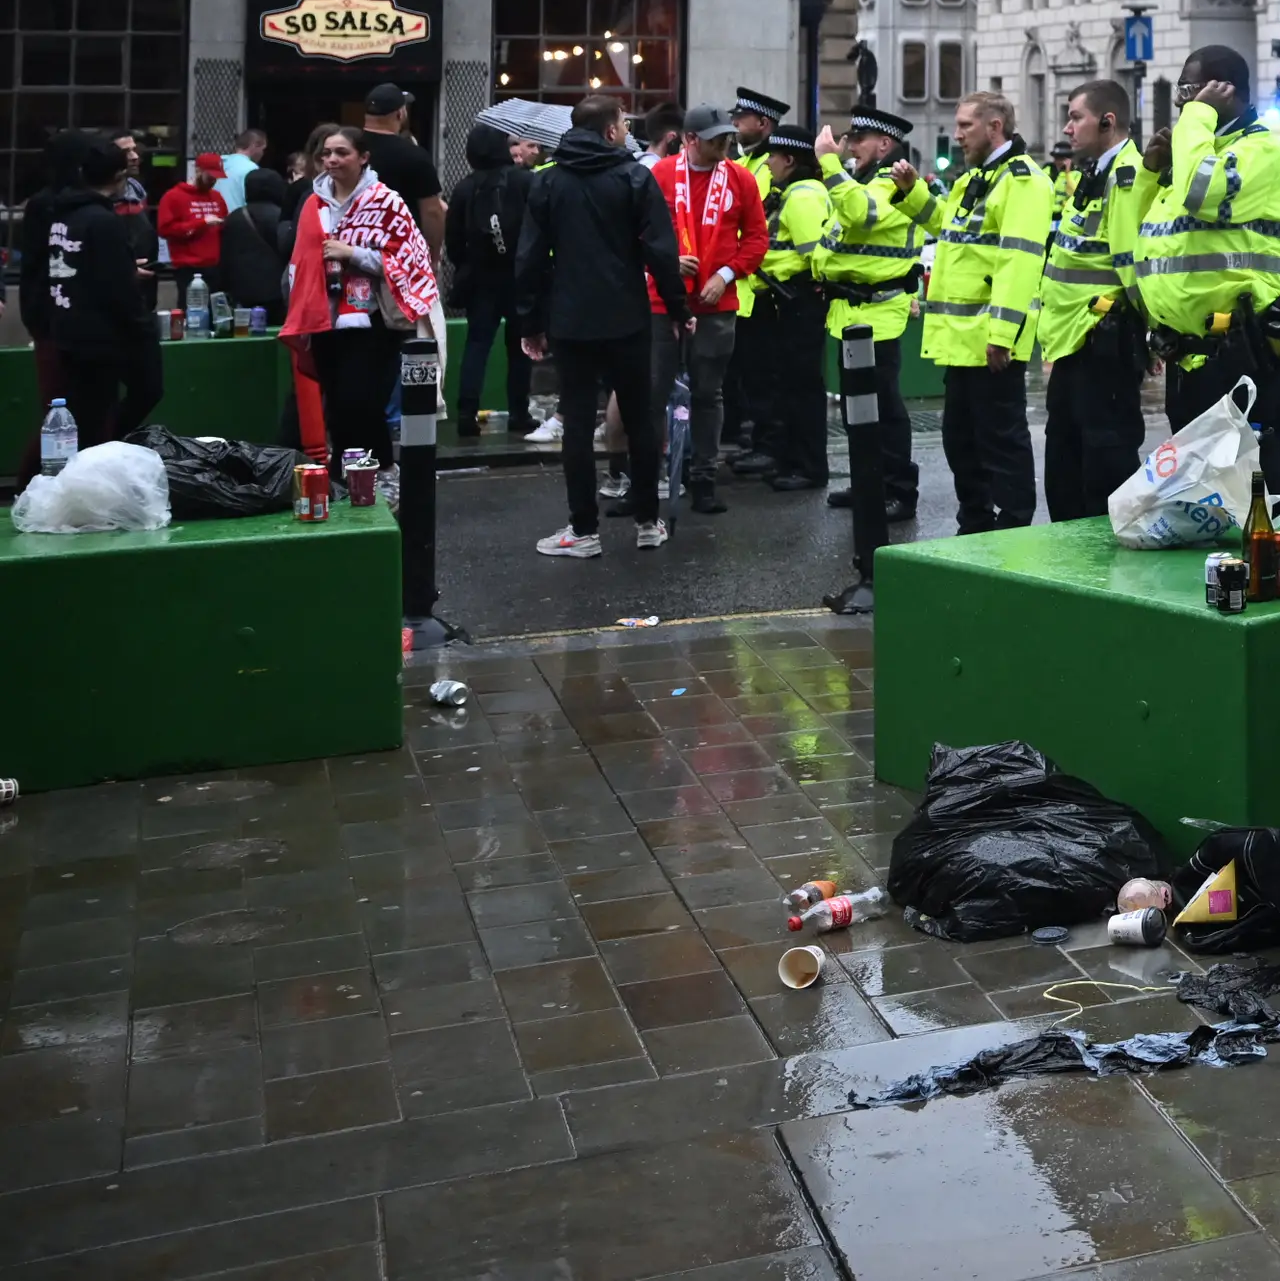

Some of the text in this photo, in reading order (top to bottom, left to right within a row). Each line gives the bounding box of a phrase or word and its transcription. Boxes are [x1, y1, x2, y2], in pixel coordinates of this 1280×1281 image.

[284, 11, 406, 35] SO SALSA
[387, 215, 409, 237] FC
